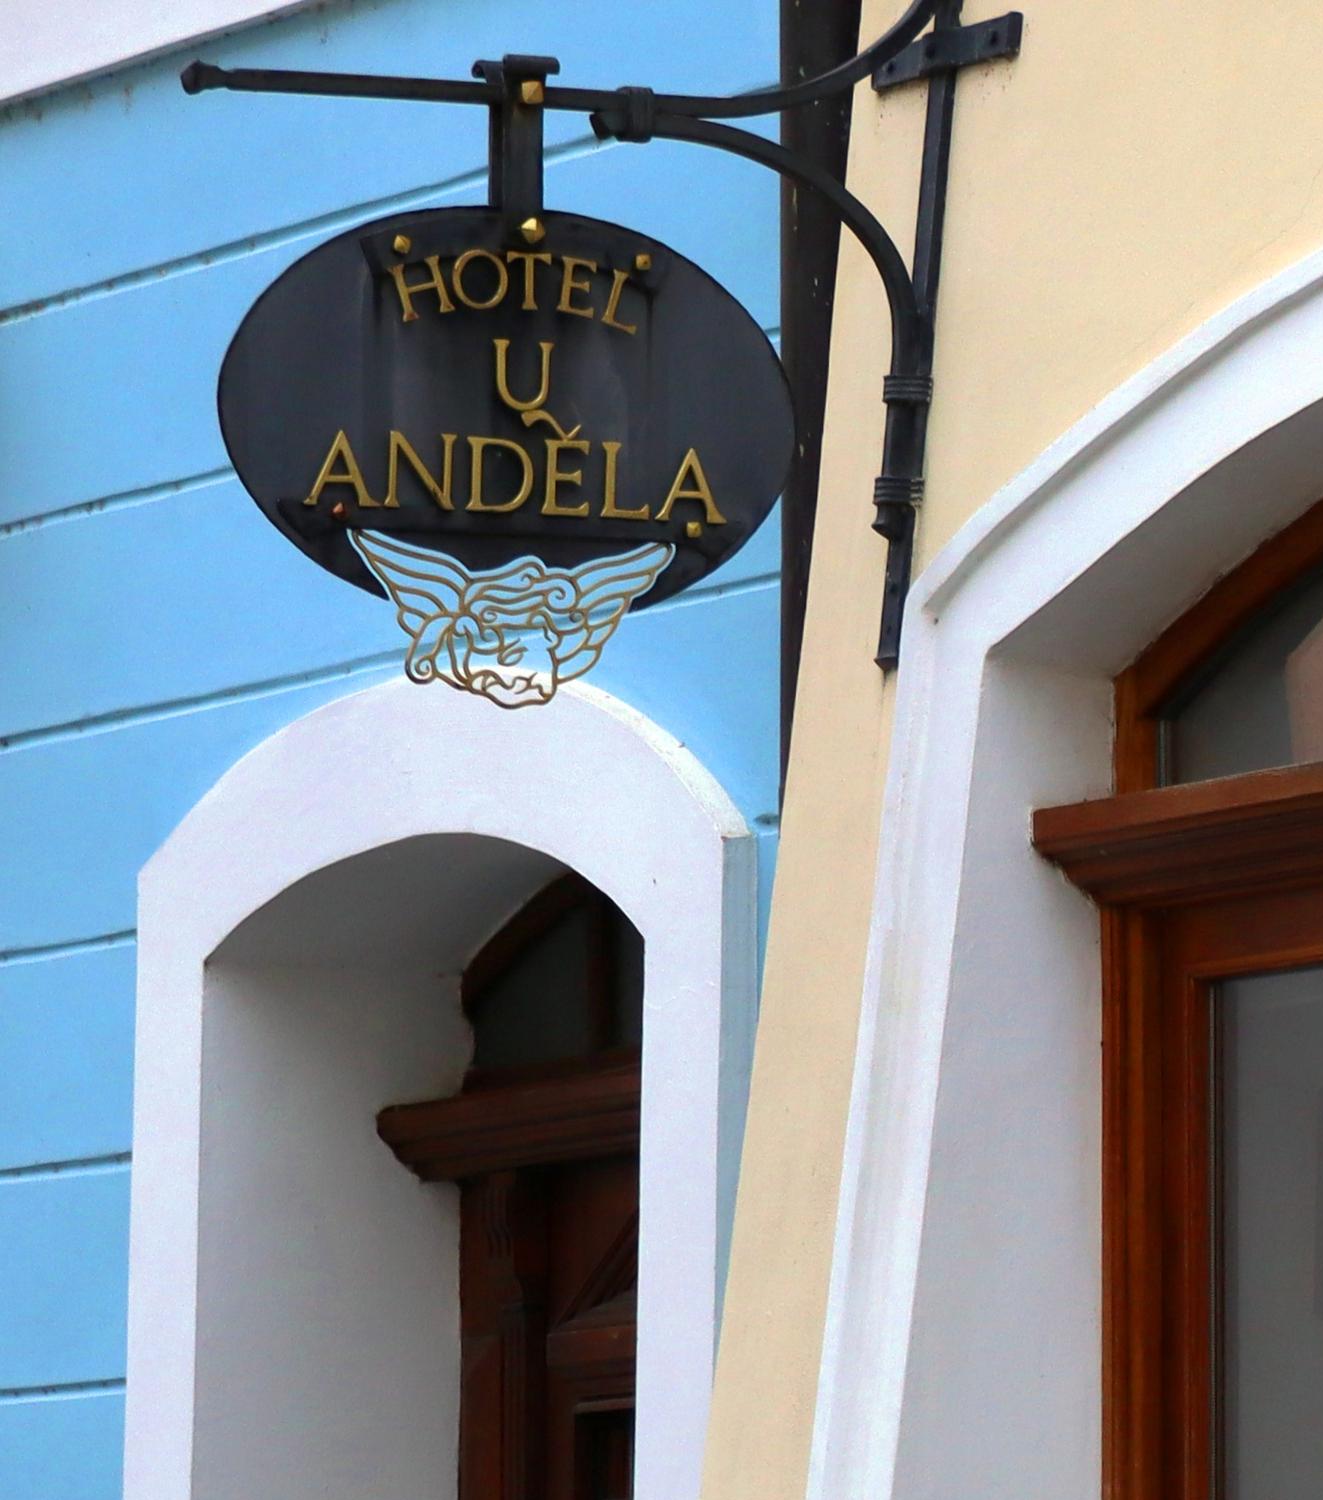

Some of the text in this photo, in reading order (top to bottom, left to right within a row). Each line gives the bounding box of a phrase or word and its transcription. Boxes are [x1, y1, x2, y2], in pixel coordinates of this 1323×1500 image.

[387, 247, 638, 336] HOTEL
[494, 338, 555, 411] U
[303, 409, 728, 526] ANDĚLA
